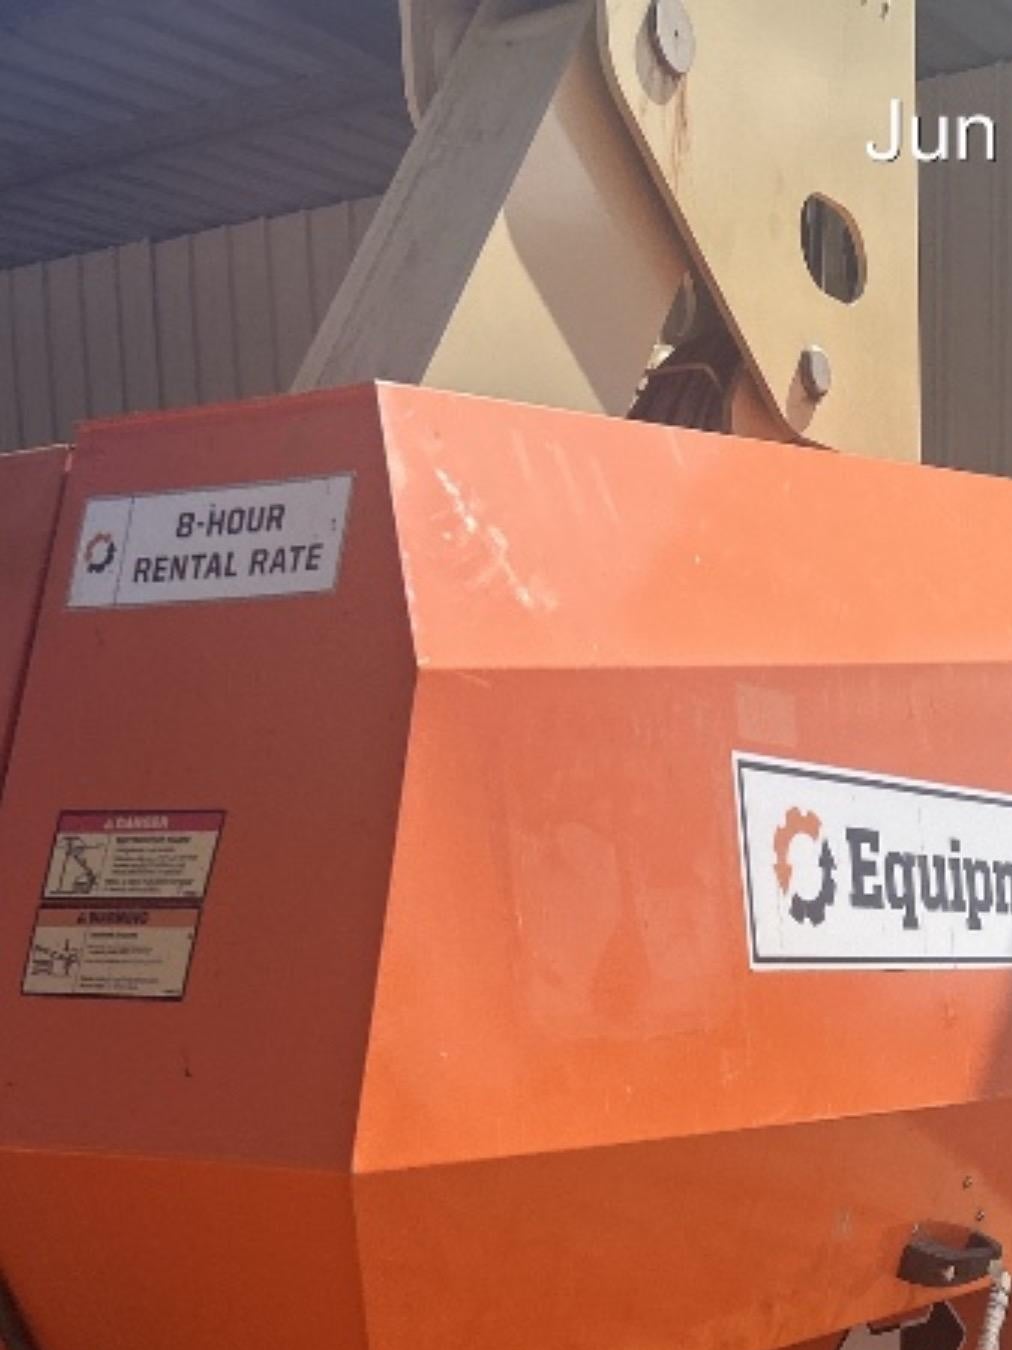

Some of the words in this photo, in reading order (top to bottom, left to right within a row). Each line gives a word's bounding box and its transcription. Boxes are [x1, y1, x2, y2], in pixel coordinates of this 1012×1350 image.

[175, 502, 286, 539] 8-HOUR
[133, 550, 238, 584] RENTAL
[247, 542, 325, 577] RATE
